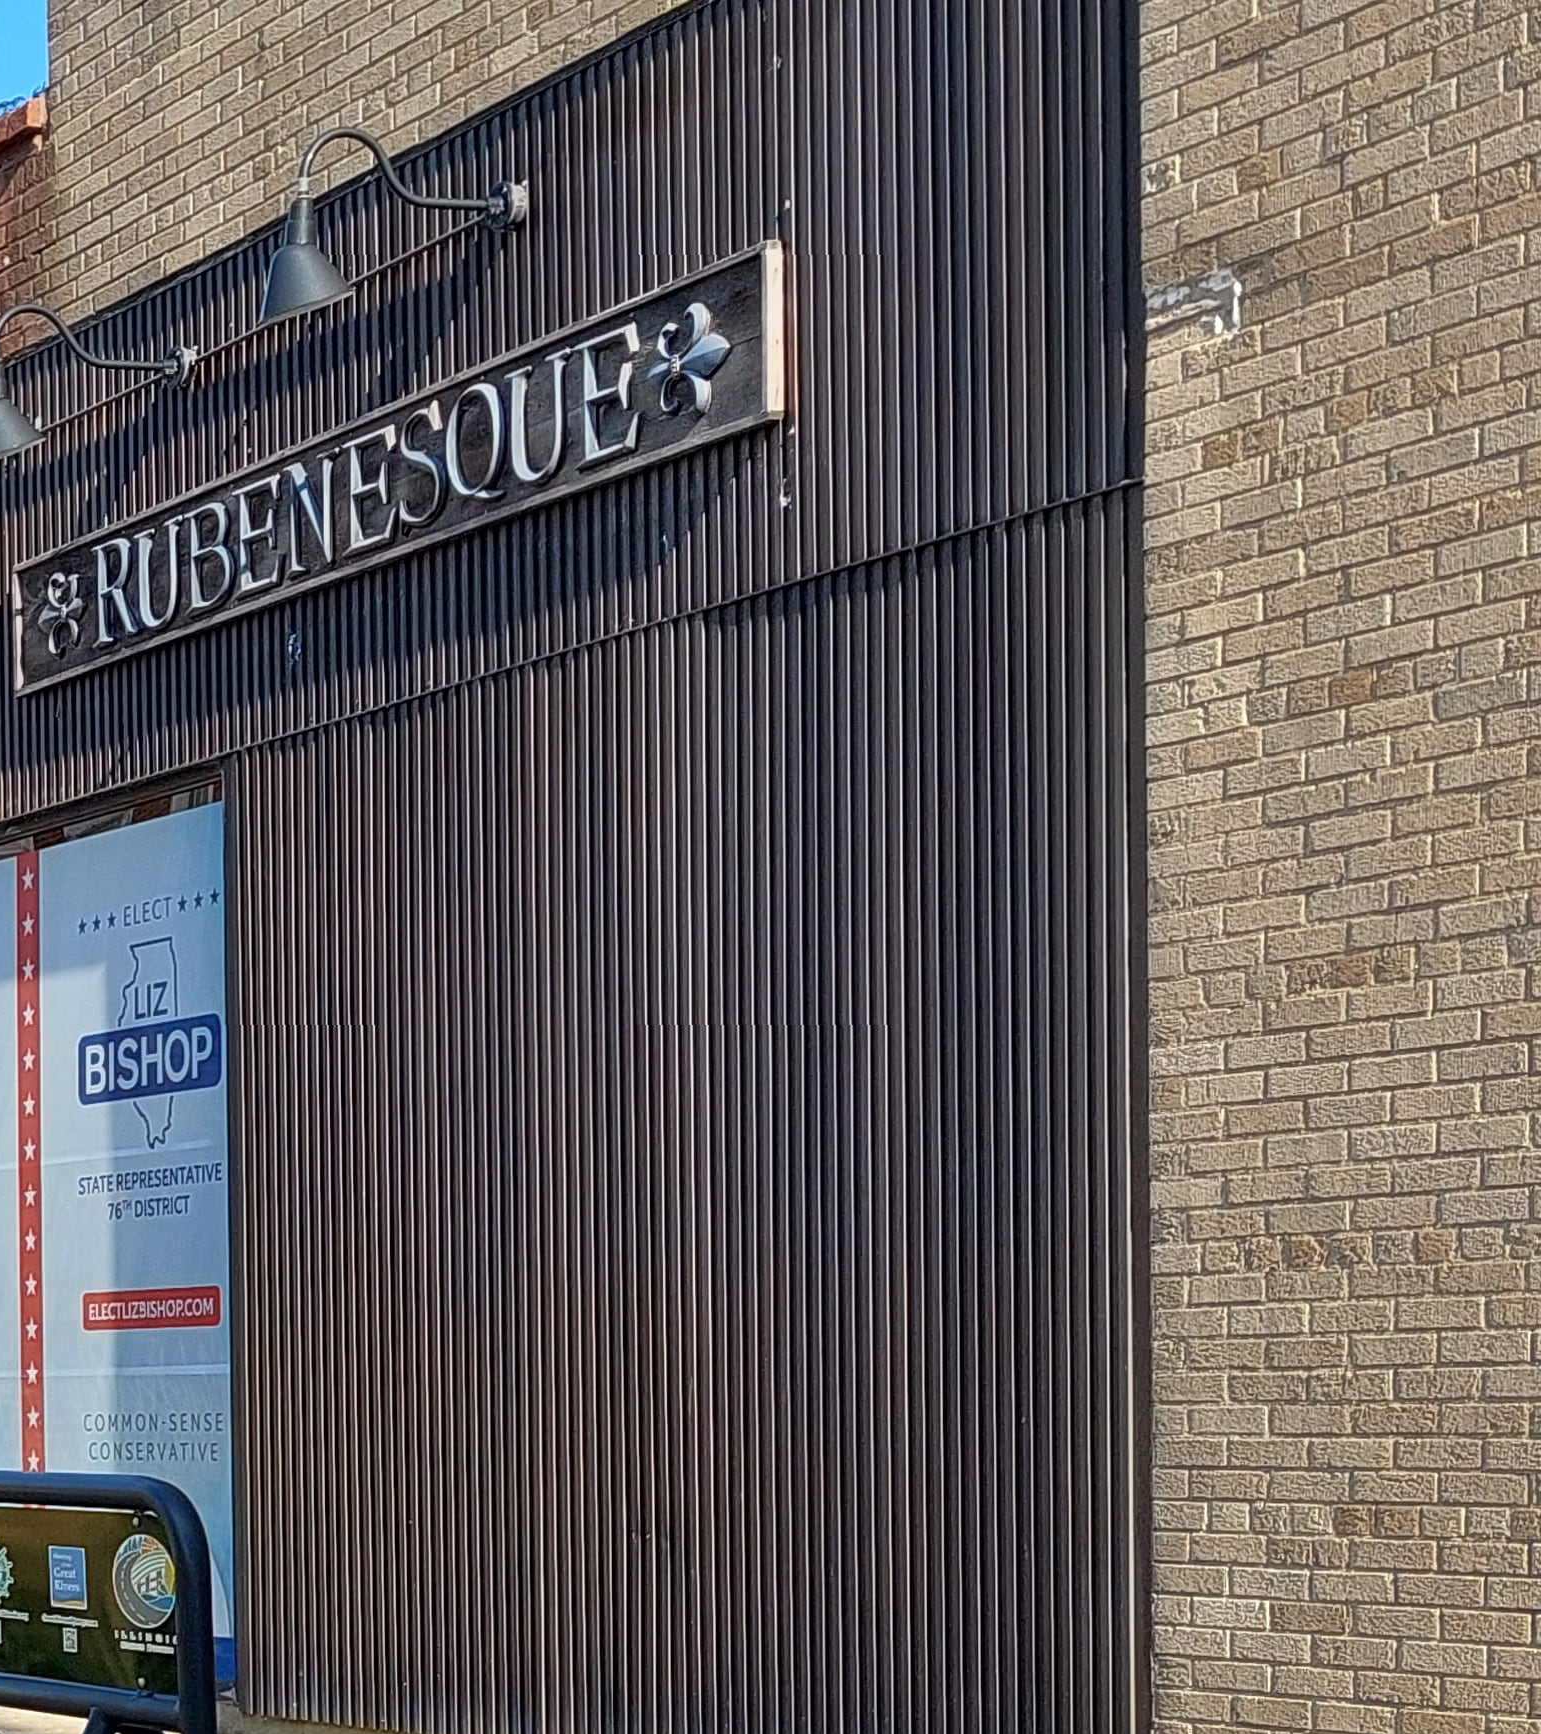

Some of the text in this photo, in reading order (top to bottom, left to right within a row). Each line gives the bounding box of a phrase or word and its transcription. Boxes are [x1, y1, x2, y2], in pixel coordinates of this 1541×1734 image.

[90, 321, 641, 648] RUBENESQUE
[123, 896, 172, 928] ELECT
[134, 980, 169, 1020] LIZ
[84, 1025, 213, 1095] BISHOP
[78, 1162, 223, 1195] STATE REPRESENTATIVE
[107, 1195, 191, 1221] 76TH DISTRICT
[88, 1297, 214, 1321] ELECTLIZBISHOP.COM
[83, 1412, 224, 1432] COMMON-SENSE
[88, 1441, 219, 1462] CONSERVATIVE
